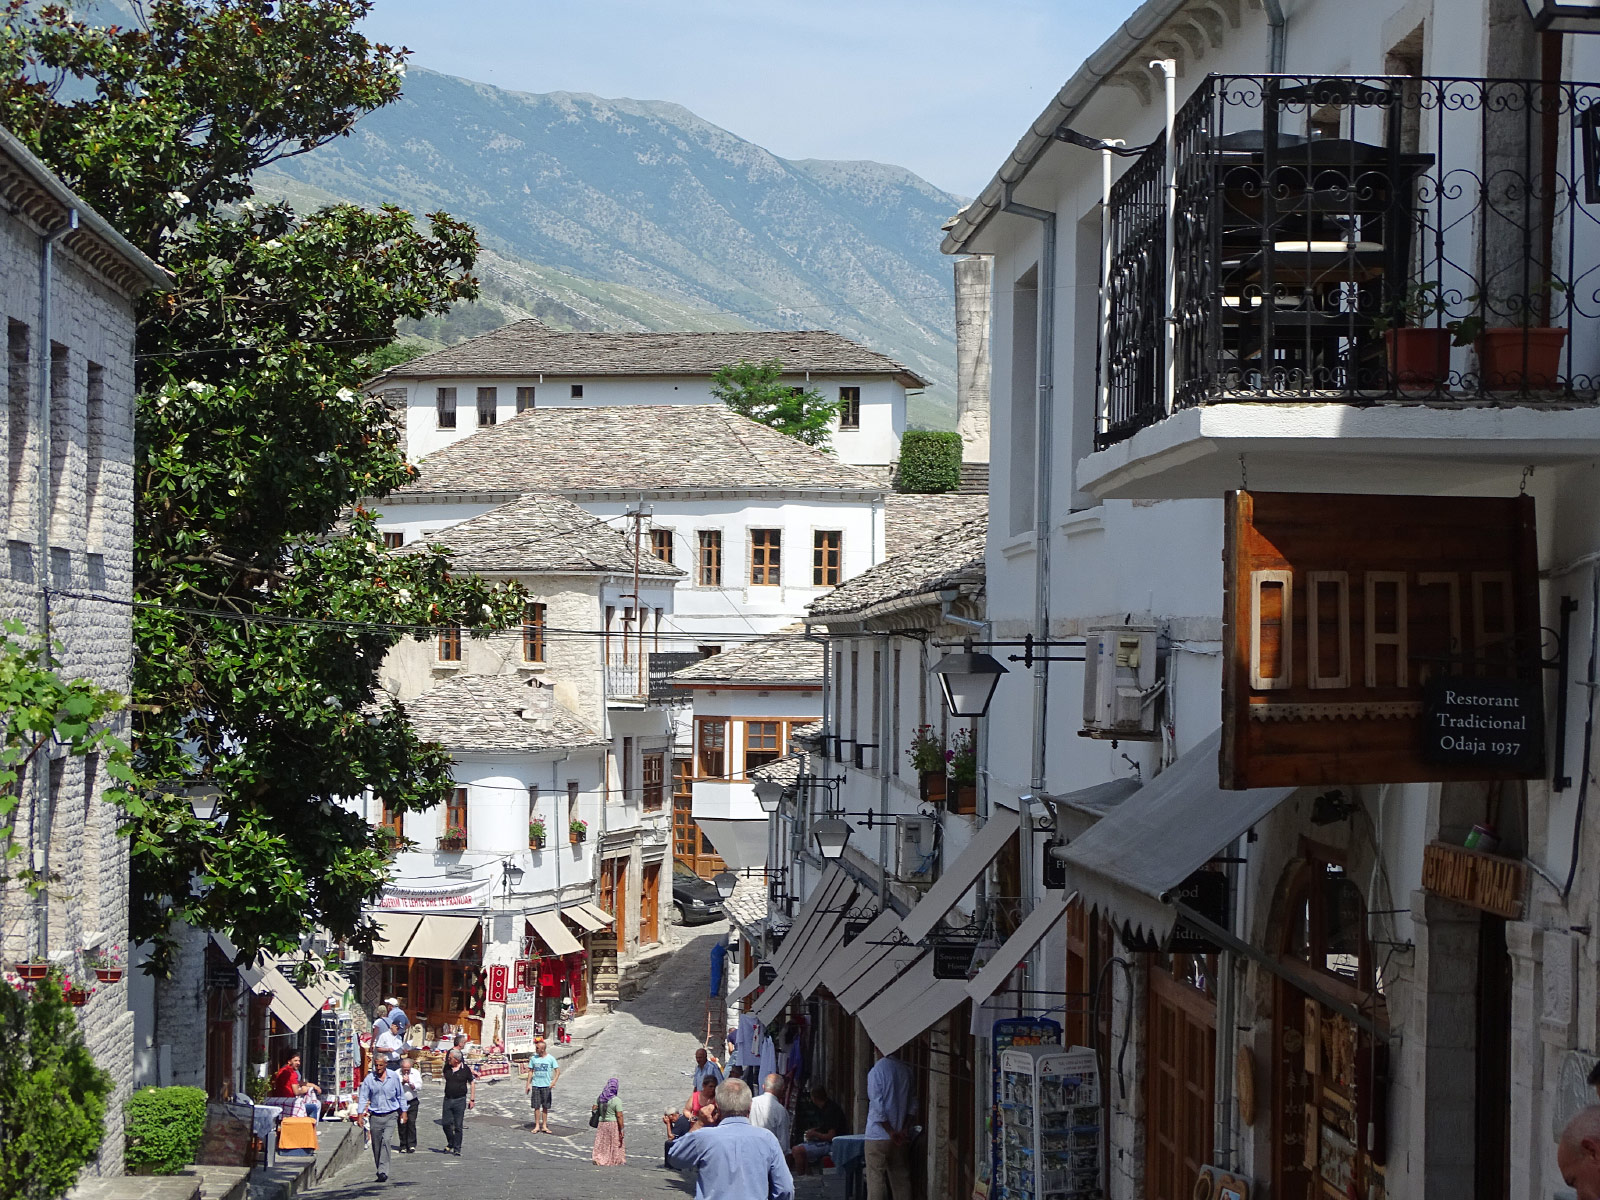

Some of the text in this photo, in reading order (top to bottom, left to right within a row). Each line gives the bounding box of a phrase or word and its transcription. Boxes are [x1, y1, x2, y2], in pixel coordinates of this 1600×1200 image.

[1445, 690, 1520, 707] Restorant
[1436, 713, 1526, 730] Tradicional
[1440, 735, 1521, 756] Odaja 1937
